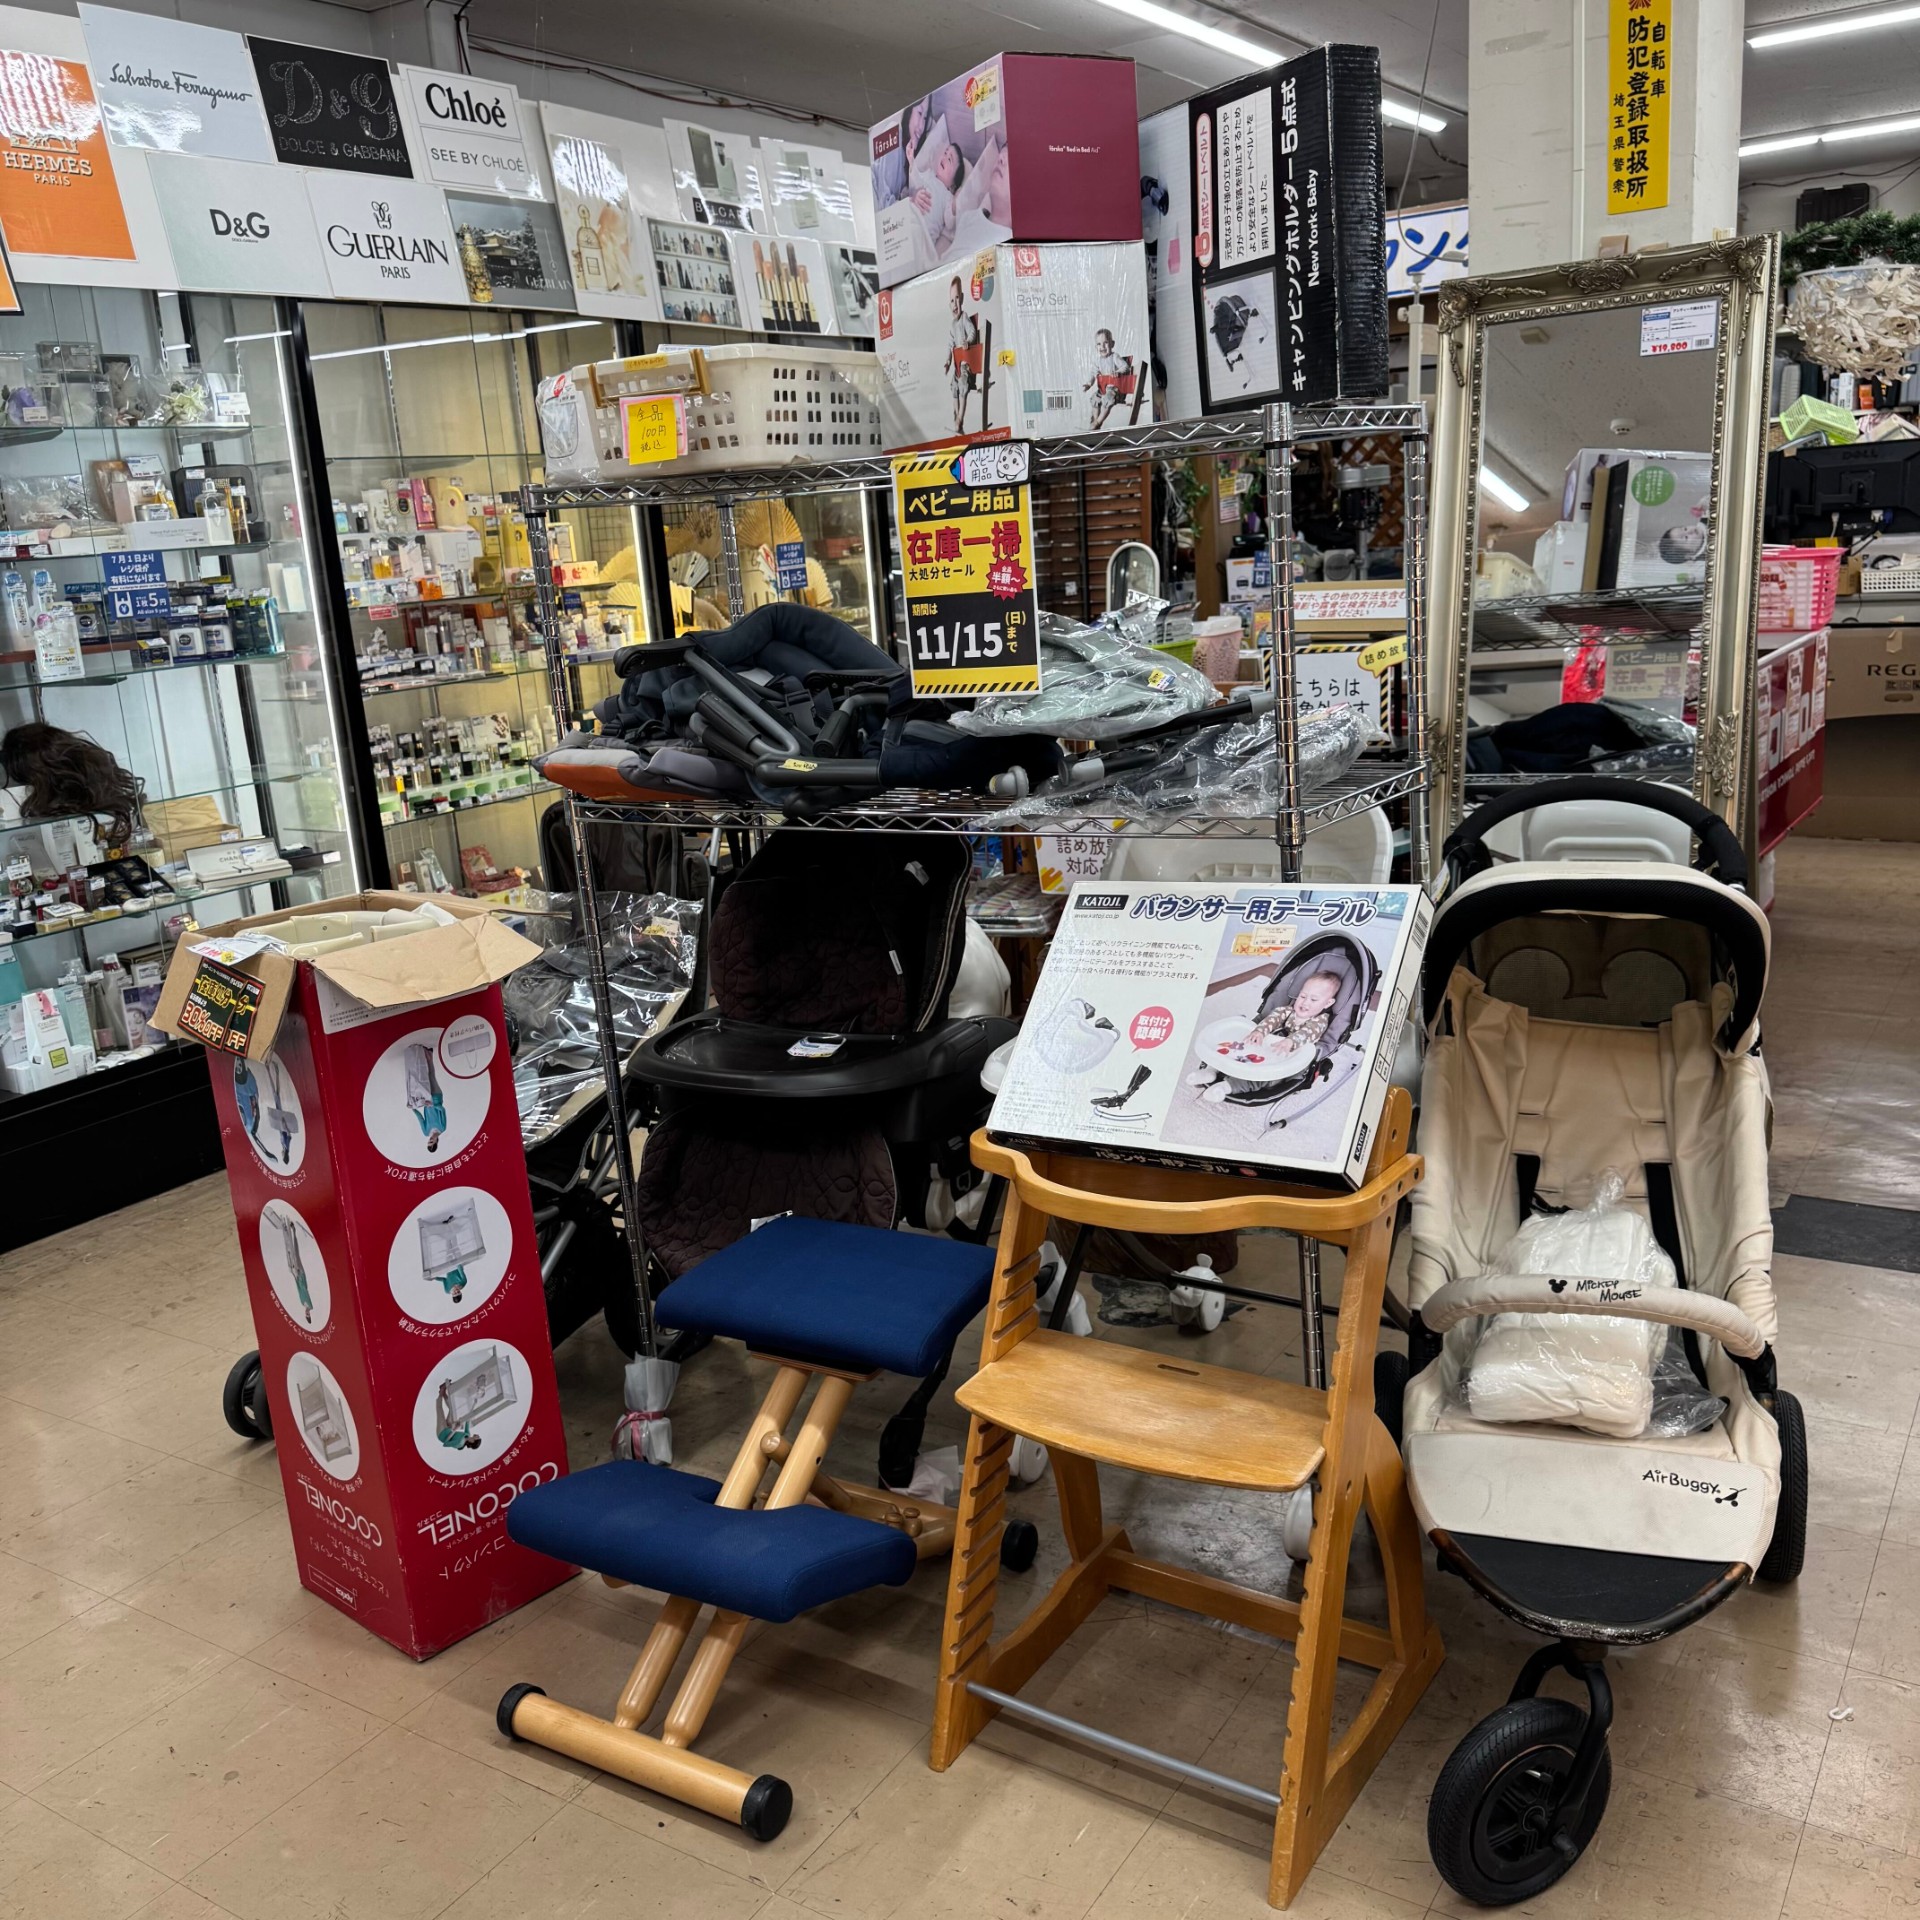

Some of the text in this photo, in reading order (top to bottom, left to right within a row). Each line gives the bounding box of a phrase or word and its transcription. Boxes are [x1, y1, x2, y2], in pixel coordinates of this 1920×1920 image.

[1650, 22, 1666, 98] 自転車
[110, 63, 252, 109] Salvatore Ferragamo
[425, 82, 507, 128] Chloé
[1626, 16, 1650, 199] 防犯登録取扱所
[279, 136, 325, 155] DOLCE
[342, 143, 406, 164] GABBANA
[1612, 94, 1625, 193] 埼玉県警察
[431, 147, 525, 173] SEE BY CHLOÉ
[33, 172, 71, 186] PARIS
[209, 208, 270, 239] D&G
[1281, 77, 1307, 391] キャンピングホルダー5点式
[327, 225, 449, 265] GUERLAIN
[381, 265, 411, 279] PARIS
[1307, 251, 1320, 287] New
[1016, 293, 1068, 308] Baby Set
[898, 360, 911, 378] Set
[908, 487, 1015, 516] ベビー用品
[907, 519, 1021, 565] 在庫一掃
[909, 564, 975, 581] 大処分セール
[911, 603, 938, 616] 期間は
[917, 621, 1003, 667] 11/15
[1867, 664, 1920, 677] REG
[1066, 857, 1106, 875] 対応
[1081, 896, 1121, 907] KATOJI
[1130, 893, 1378, 927] バウンサー用テーブル
[182, 1001, 224, 1042] 30%OFF
[1137, 1014, 1171, 1029] 取付け
[1642, 1469, 1721, 1494] AirBuggy
[297, 1477, 383, 1547] COCONEL
